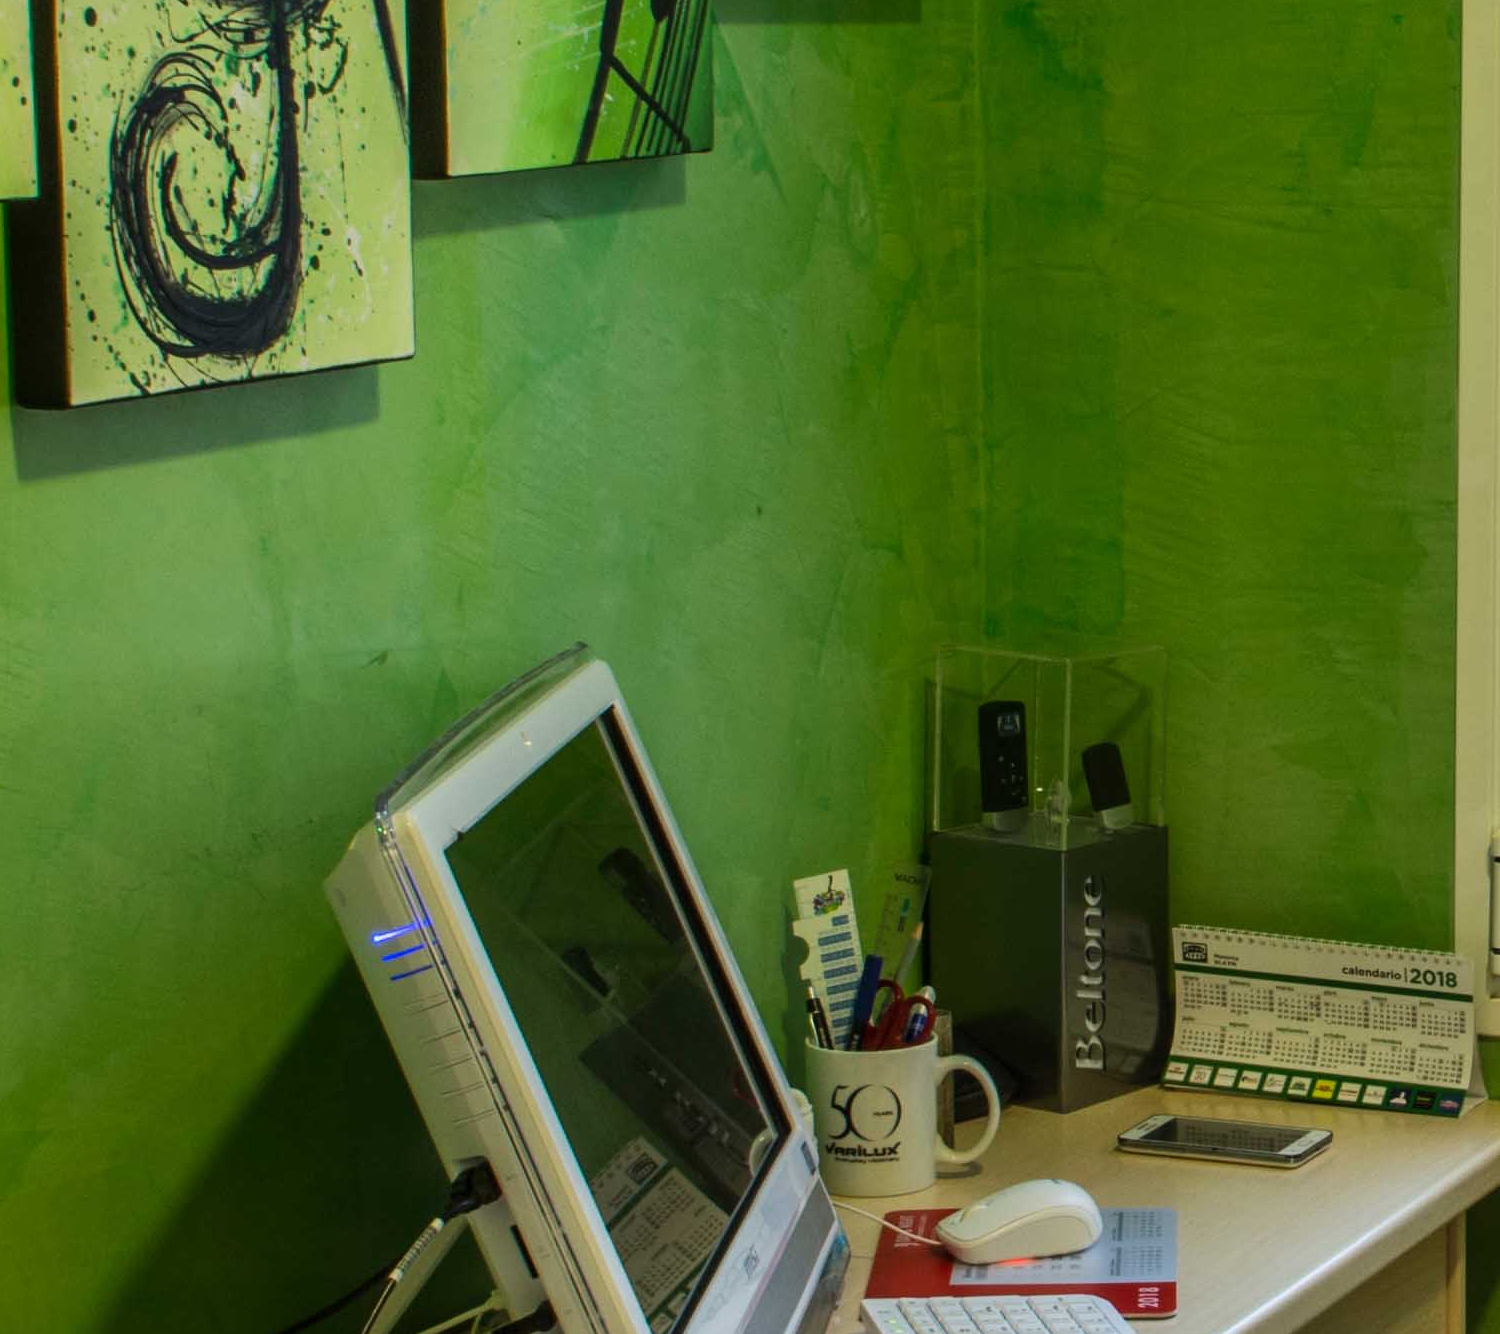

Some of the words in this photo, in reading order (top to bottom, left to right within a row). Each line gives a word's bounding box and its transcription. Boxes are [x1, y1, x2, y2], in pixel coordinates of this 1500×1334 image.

[1075, 873, 1104, 1070] Beltone
[1342, 965, 1402, 981] calendario
[1409, 968, 1458, 989] 2018
[827, 1083, 902, 1143] 50
[1138, 1286, 1161, 1309] 2018
